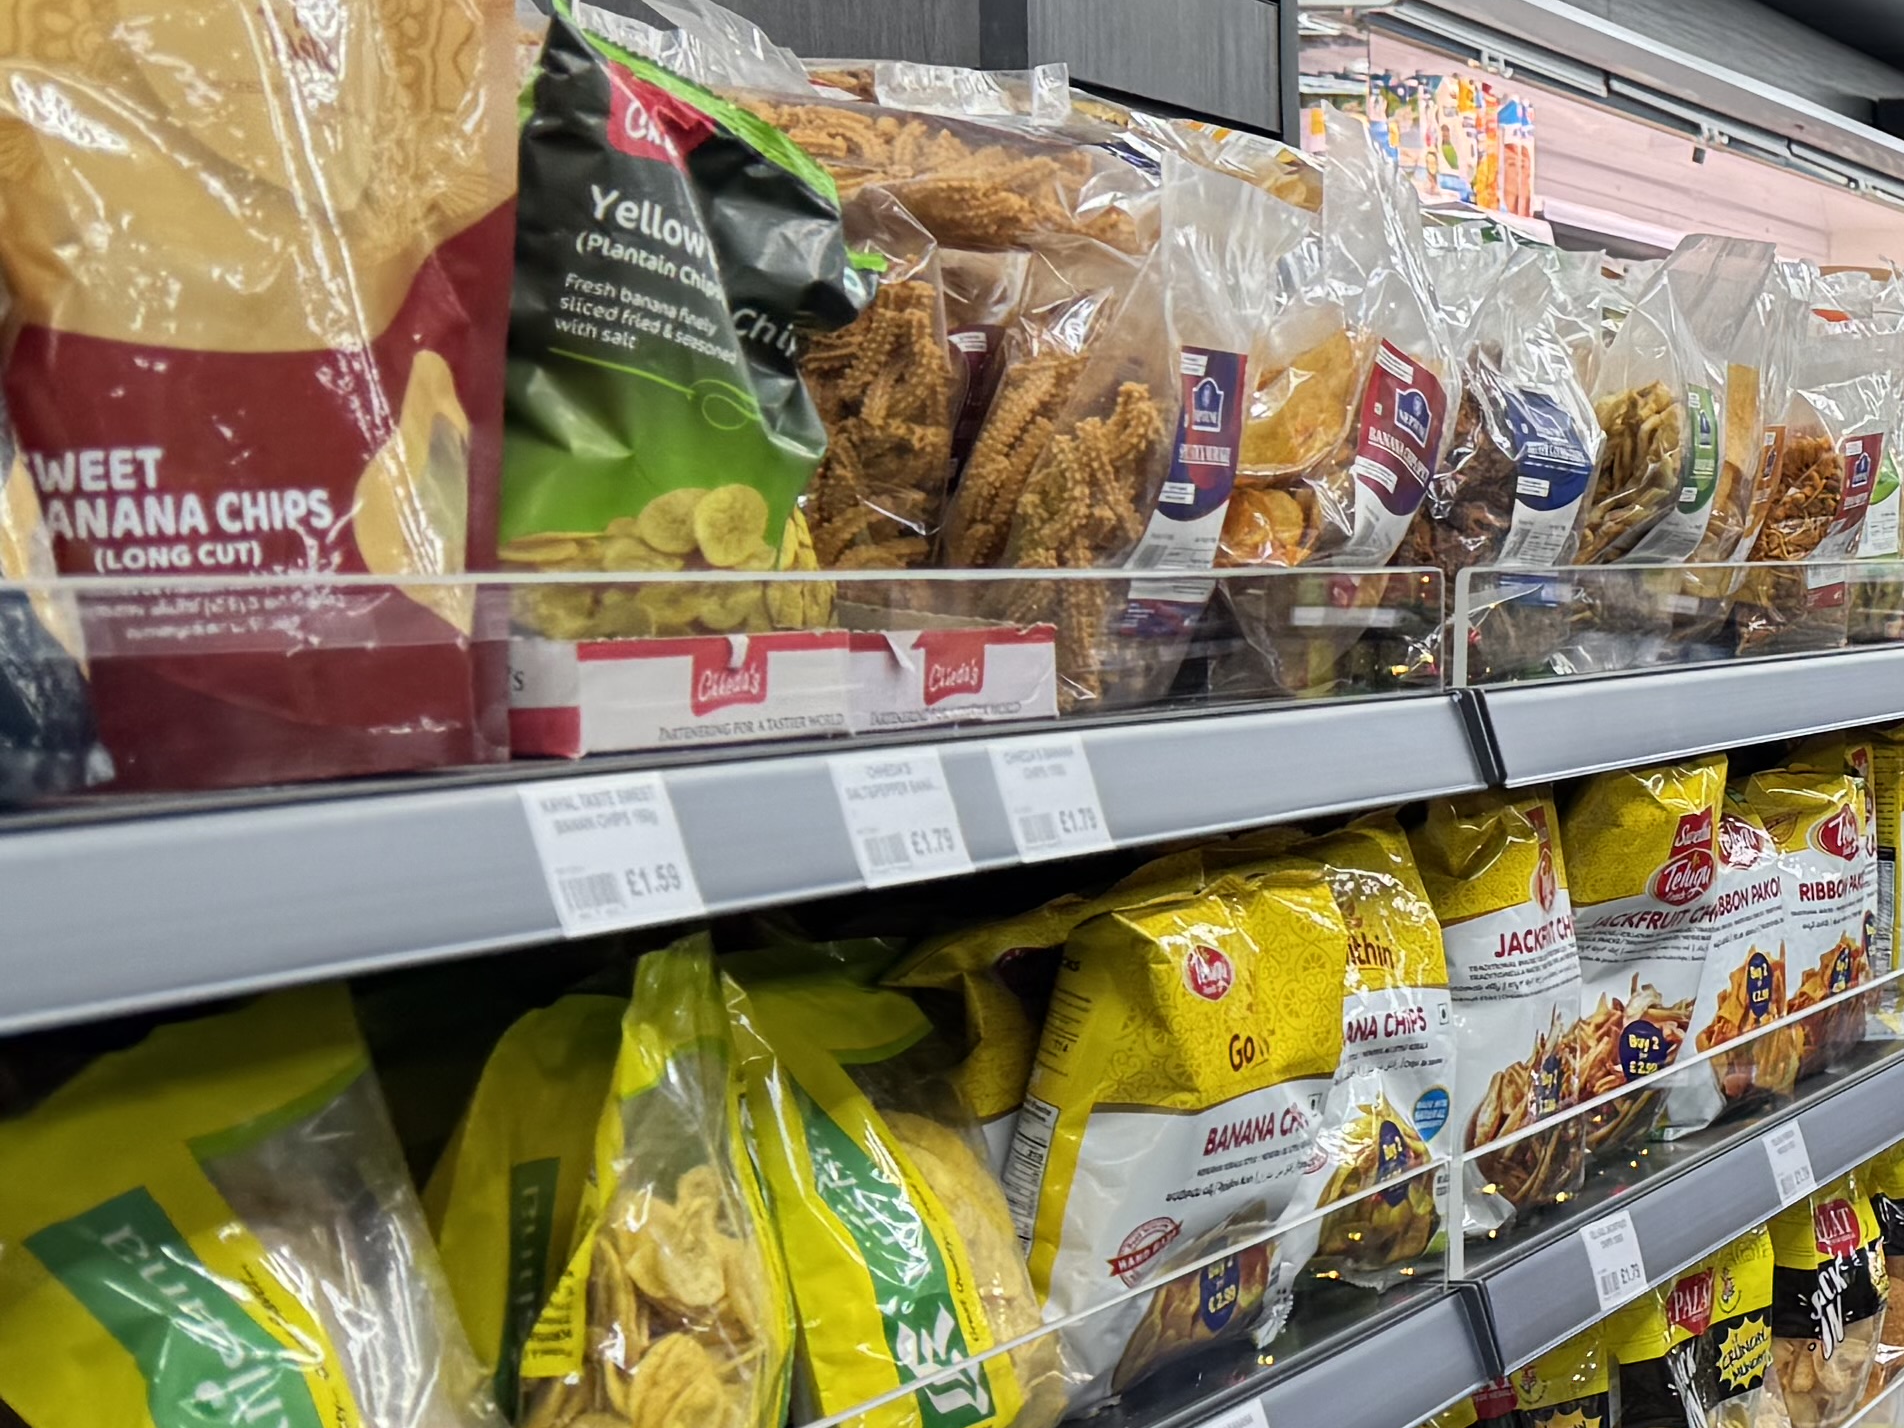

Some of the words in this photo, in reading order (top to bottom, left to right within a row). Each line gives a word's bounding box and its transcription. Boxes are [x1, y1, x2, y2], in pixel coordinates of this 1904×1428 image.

[590, 184, 709, 258] Yellow
[576, 231, 676, 280] (Plantain
[565, 273, 616, 299] Fresh
[620, 288, 679, 318] banana
[554, 318, 598, 338] with
[601, 328, 638, 349] salt
[559, 295, 618, 323] sliced
[621, 311, 661, 338] fried
[675, 330, 737, 365] seasoned
[30, 448, 163, 493] WEET
[45, 494, 207, 540] ANANA
[216, 489, 333, 532] CHIPS
[93, 545, 190, 572] (LONG
[197, 541, 262, 567] CUT)
[1059, 808, 1098, 833] £1.79
[910, 828, 954, 855] £1.79
[626, 864, 682, 898] £1.59
[1663, 858, 1713, 895] Telugu
[1384, 1008, 1427, 1038] CHIPS
[1203, 1112, 1276, 1156] BANANA
